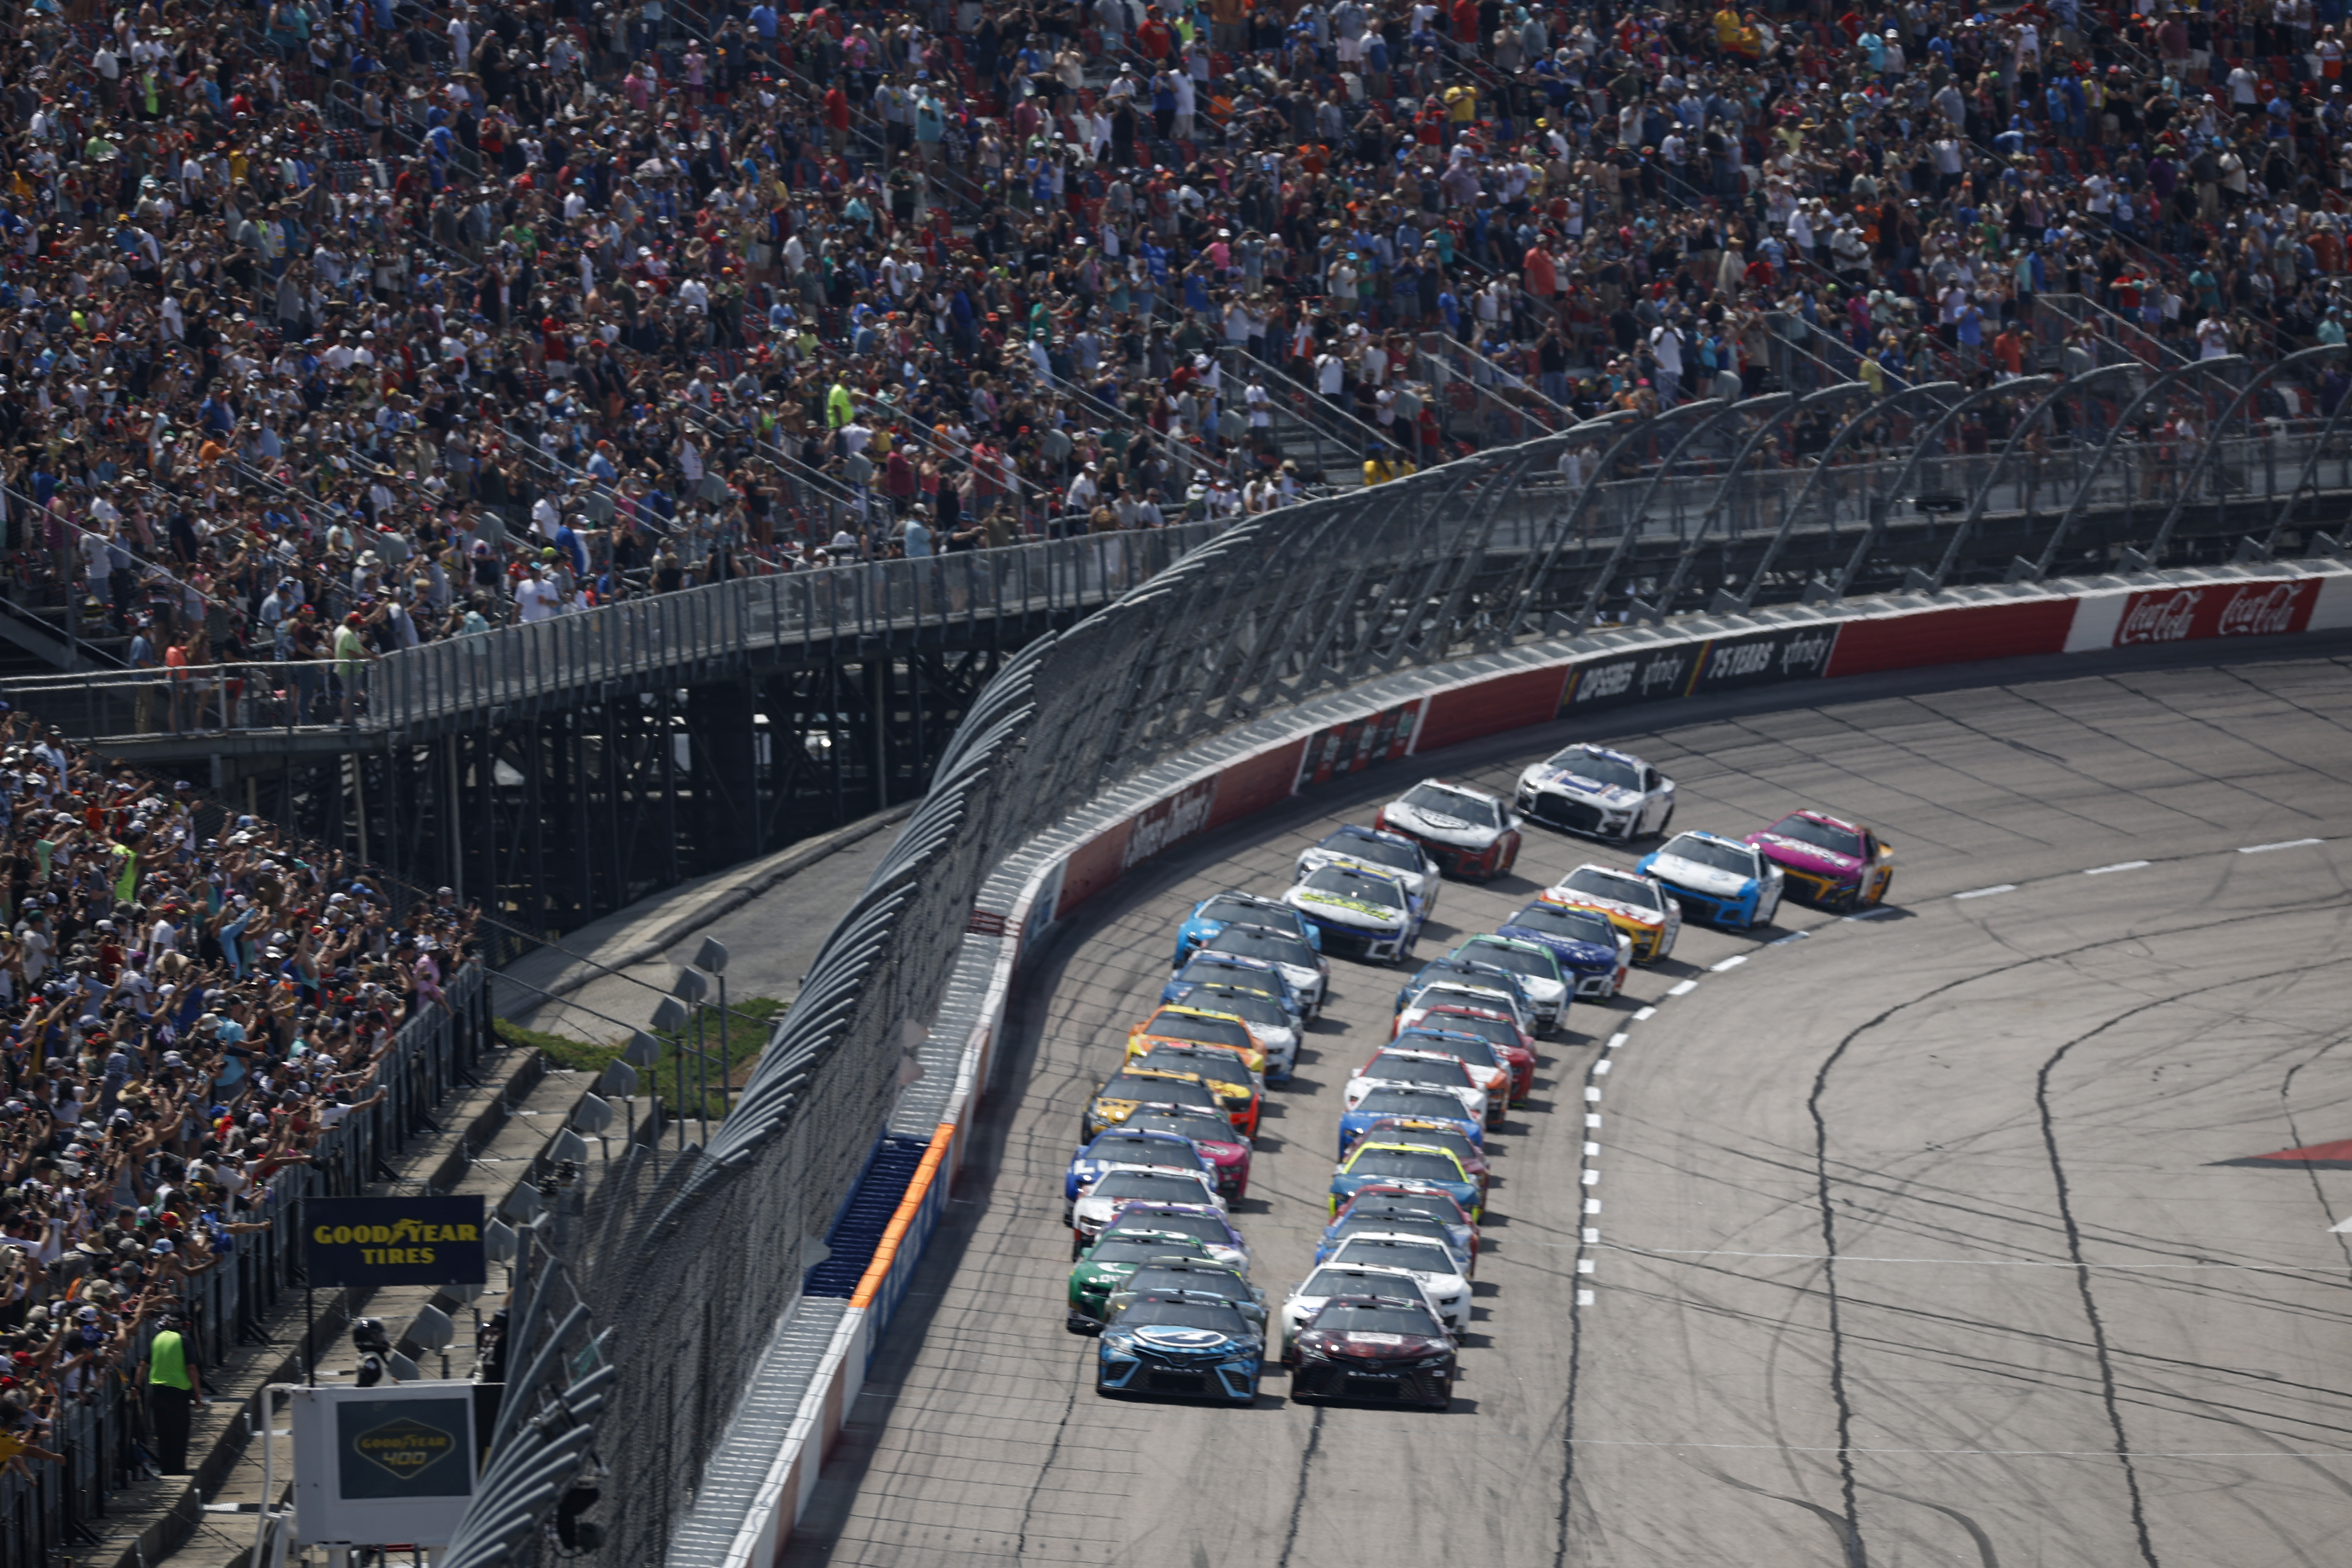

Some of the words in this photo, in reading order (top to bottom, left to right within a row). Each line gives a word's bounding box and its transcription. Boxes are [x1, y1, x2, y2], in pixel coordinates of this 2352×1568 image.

[1779, 632, 1831, 674] xfinity
[1639, 652, 1685, 696] xfinity
[313, 1220, 481, 1245] GOODYEAR
[360, 1247, 436, 1264] TIRES
[361, 1435, 447, 1449] GOODYEAR
[383, 1451, 427, 1465] 400
